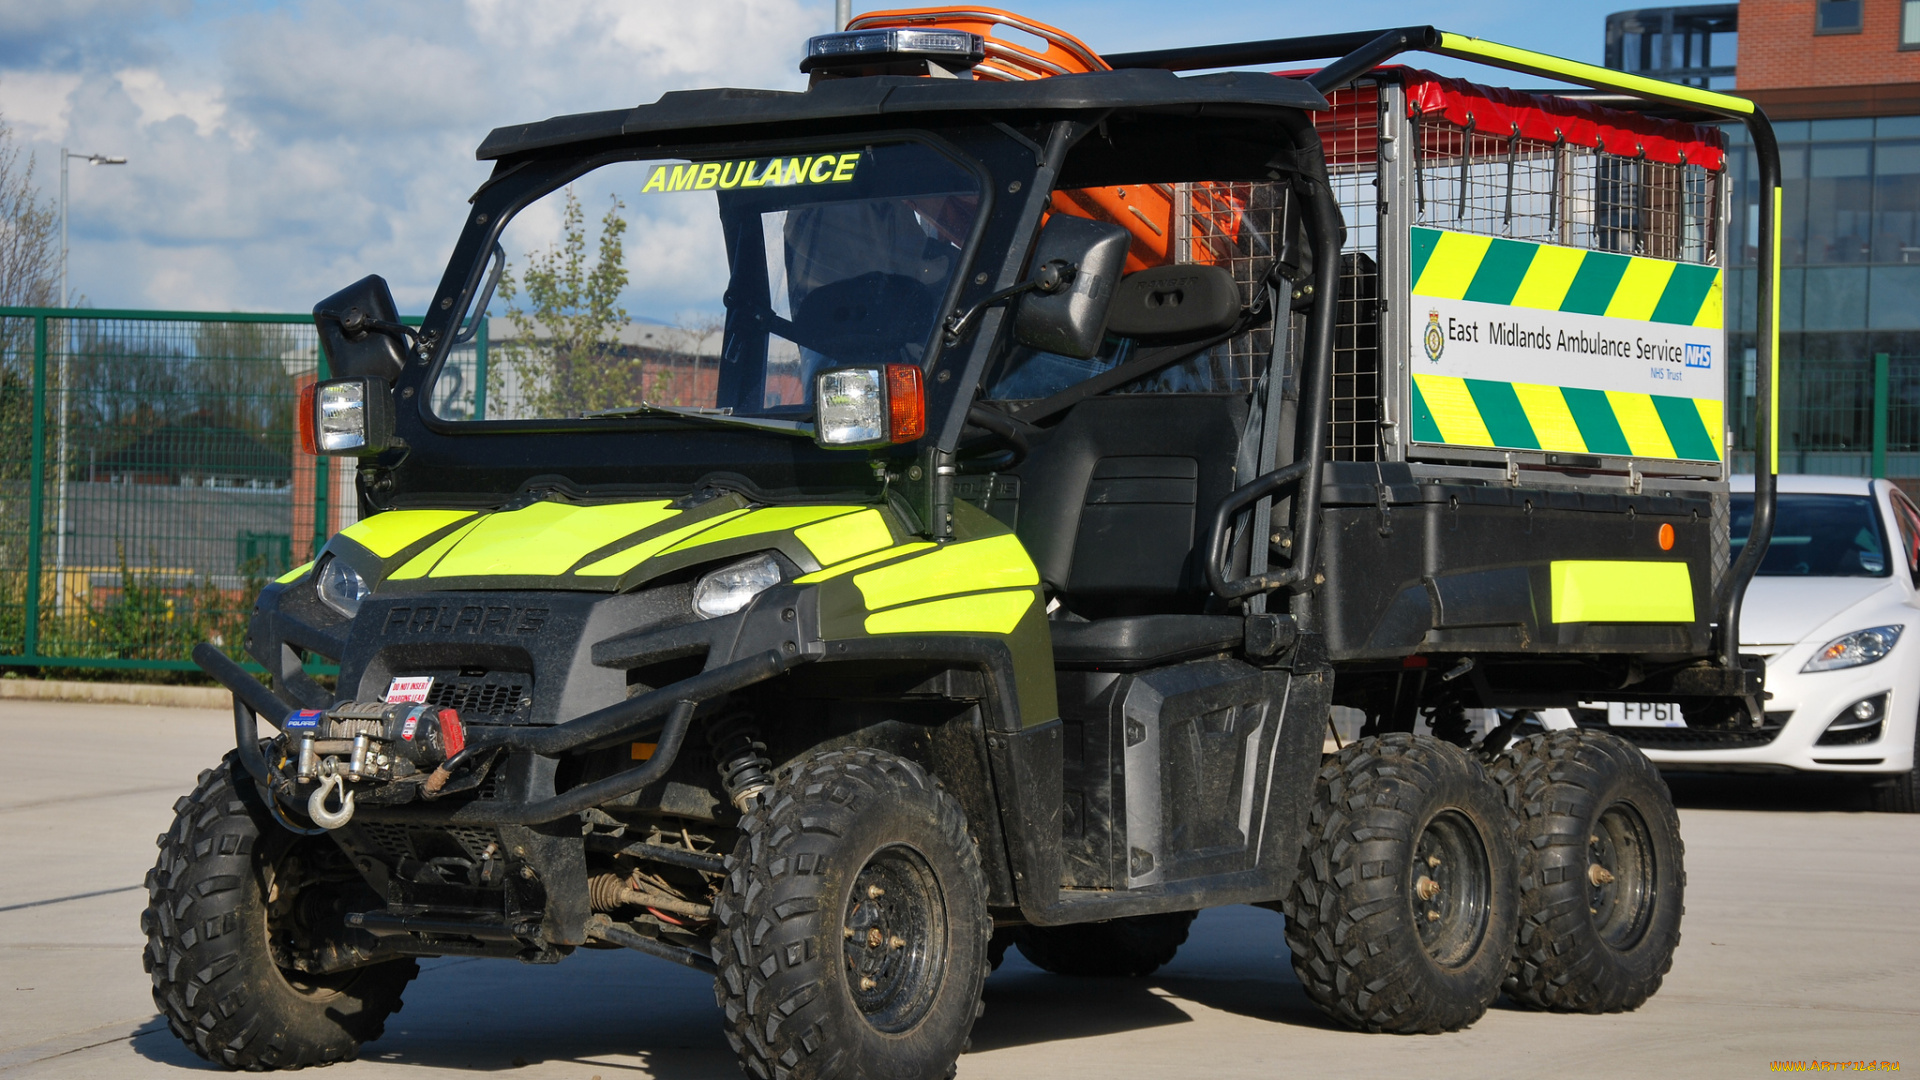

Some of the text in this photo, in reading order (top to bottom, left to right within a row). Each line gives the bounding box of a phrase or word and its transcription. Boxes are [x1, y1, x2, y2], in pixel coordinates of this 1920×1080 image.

[641, 153, 860, 193] AMBULANCE
[1134, 276, 1199, 290] RANGER
[1448, 317, 1711, 367] East Midlands Ambulance Service NHS
[1650, 367, 1682, 381] NHS Trust
[380, 605, 550, 636] POLARIS
[392, 682, 429, 691] DO NOT INSERT
[388, 694, 426, 703] CHARGING LEAD
[1624, 702, 1674, 721] FP61
